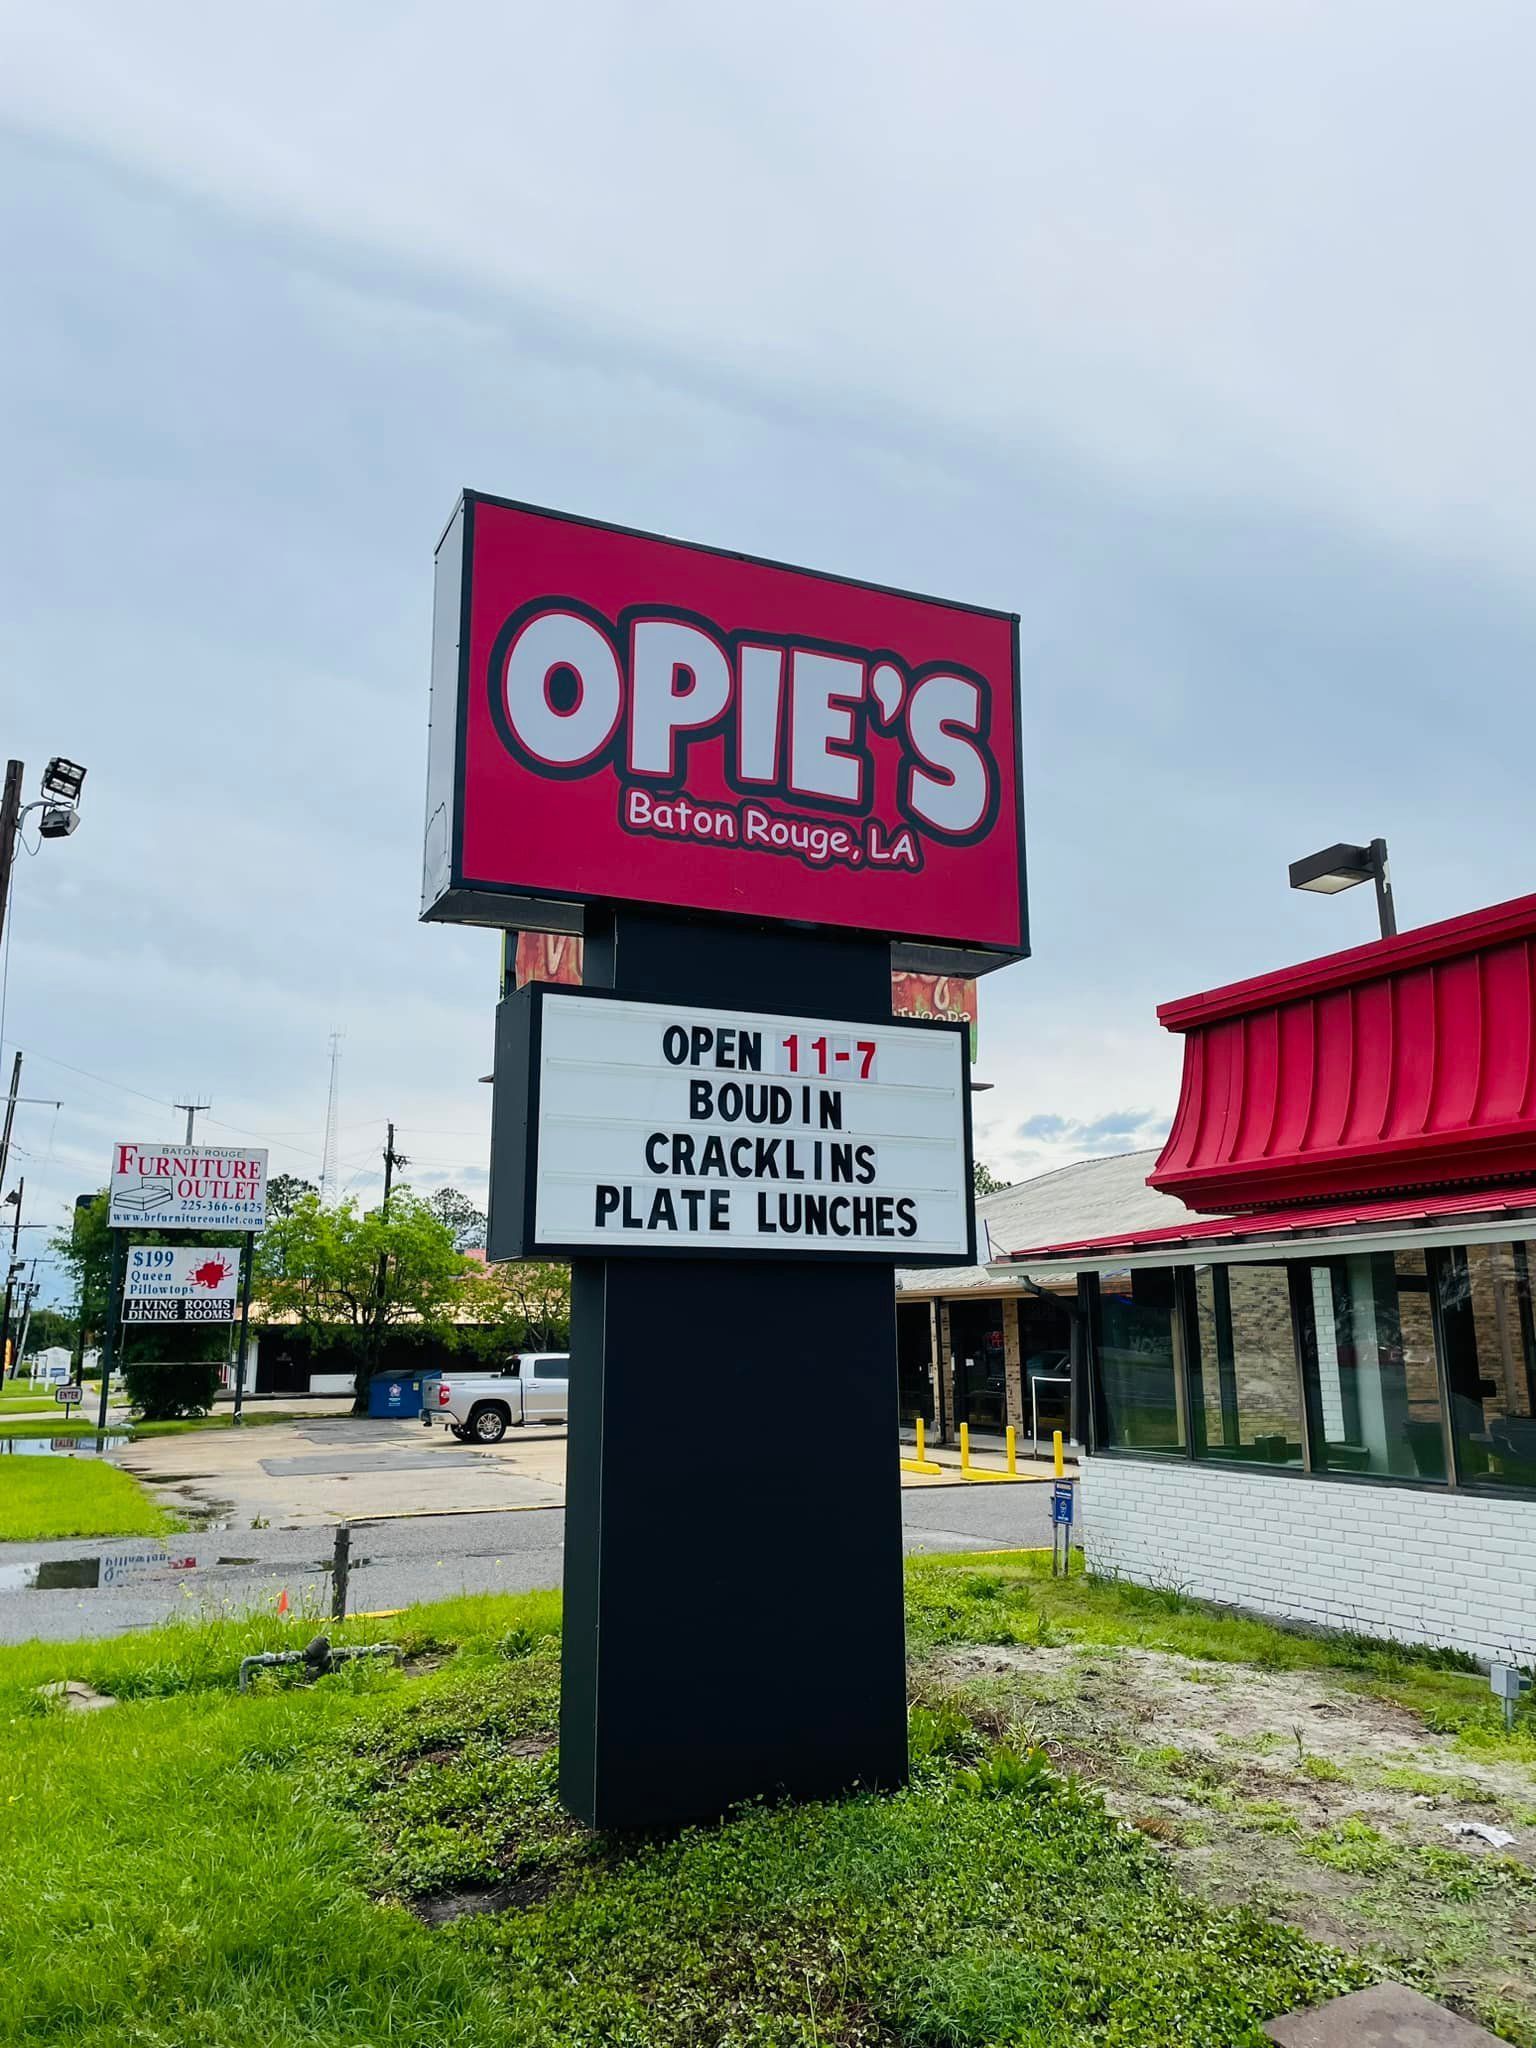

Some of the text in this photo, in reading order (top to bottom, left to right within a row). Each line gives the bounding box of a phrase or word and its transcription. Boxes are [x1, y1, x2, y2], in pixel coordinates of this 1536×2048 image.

[506, 613, 988, 831] OPIE'S
[629, 791, 915, 862] Baton Rouge, LA
[662, 1024, 877, 1079] OPEN 11-7
[689, 1079, 842, 1130] BOUDIN
[162, 1147, 243, 1158] BATON ROUGE
[645, 1132, 877, 1185] CRACKLINS
[116, 1145, 261, 1180] FURNITURE
[177, 1179, 260, 1200] OUTLET
[180, 1200, 263, 1213] 225-366-6425
[595, 1184, 918, 1237] PLATE LUNCHES
[113, 1212, 263, 1225] www.brfurnitureoutlet.com
[133, 1250, 174, 1267] $199
[131, 1270, 172, 1283] Queen
[130, 1284, 194, 1296] Pillowtops
[130, 1299, 230, 1310] LIVING ROOMS
[127, 1309, 231, 1320] DINING ROOMS
[59, 1391, 79, 1401] ENTER
